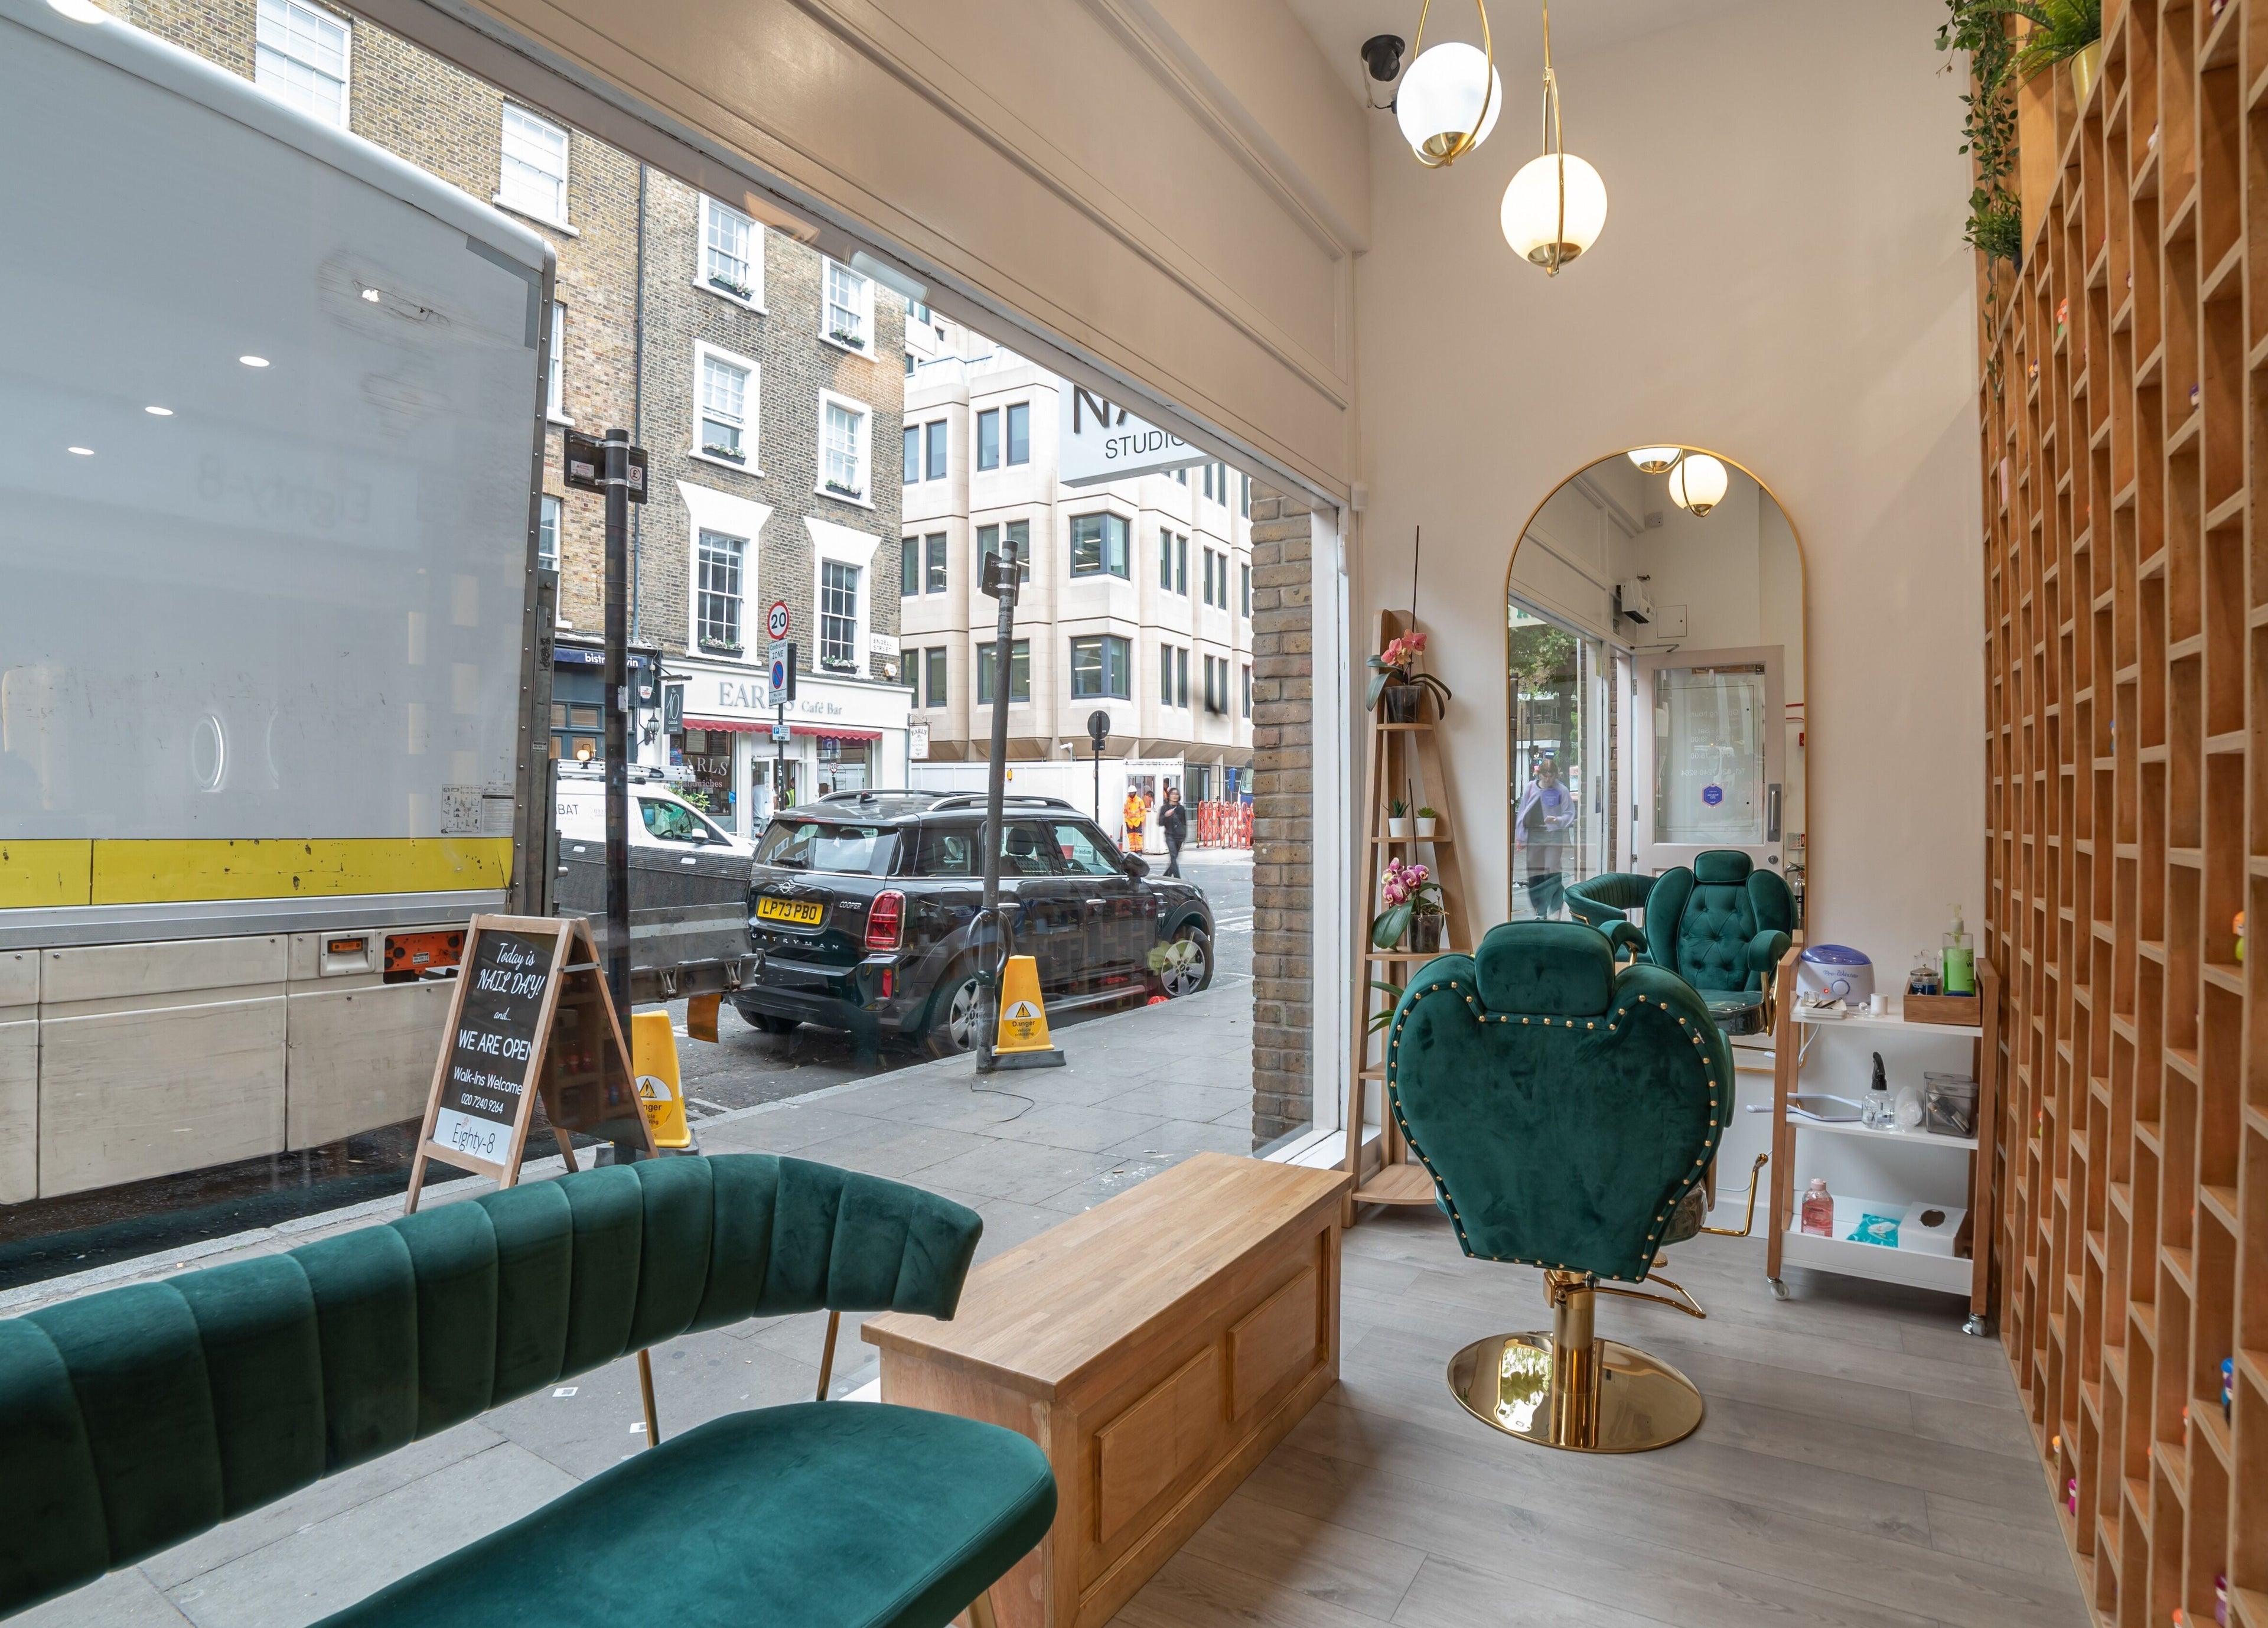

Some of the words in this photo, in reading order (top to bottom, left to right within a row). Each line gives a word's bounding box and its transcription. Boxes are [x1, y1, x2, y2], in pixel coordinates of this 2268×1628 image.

[1073, 385, 1129, 434] N
[771, 612, 787, 630] 20
[770, 640, 787, 651] Controlled
[772, 649, 784, 660] ZONE
[584, 653, 605, 664] bistr
[666, 693, 680, 720] 10
[718, 681, 795, 711] EAR
[801, 700, 825, 715] Café
[827, 701, 843, 715] Bar
[911, 728, 927, 736] EARLS
[687, 757, 729, 776] ARLS
[556, 804, 578, 815] BAT
[762, 900, 791, 917] LP73
[793, 904, 817, 921] PBO
[839, 901, 862, 910] COOPER
[752, 933, 839, 950] UNTRYMAN
[497, 943, 524, 971] Today
[525, 950, 535, 966] is
[477, 969, 511, 993] NAIL
[510, 972, 546, 999] DAY!
[458, 1028, 478, 1050] WE
[477, 1033, 503, 1056] ARE
[503, 1037, 532, 1061] OPEN
[454, 1066, 486, 1086] Walk-Ins
[487, 1073, 523, 1095] Welcome
[461, 1093, 472, 1106] 020
[472, 1096, 488, 1111] 7240
[488, 1099, 504, 1115] 9264
[644, 1104, 662, 1112] nger
[452, 1122, 496, 1155] Eighty-8
